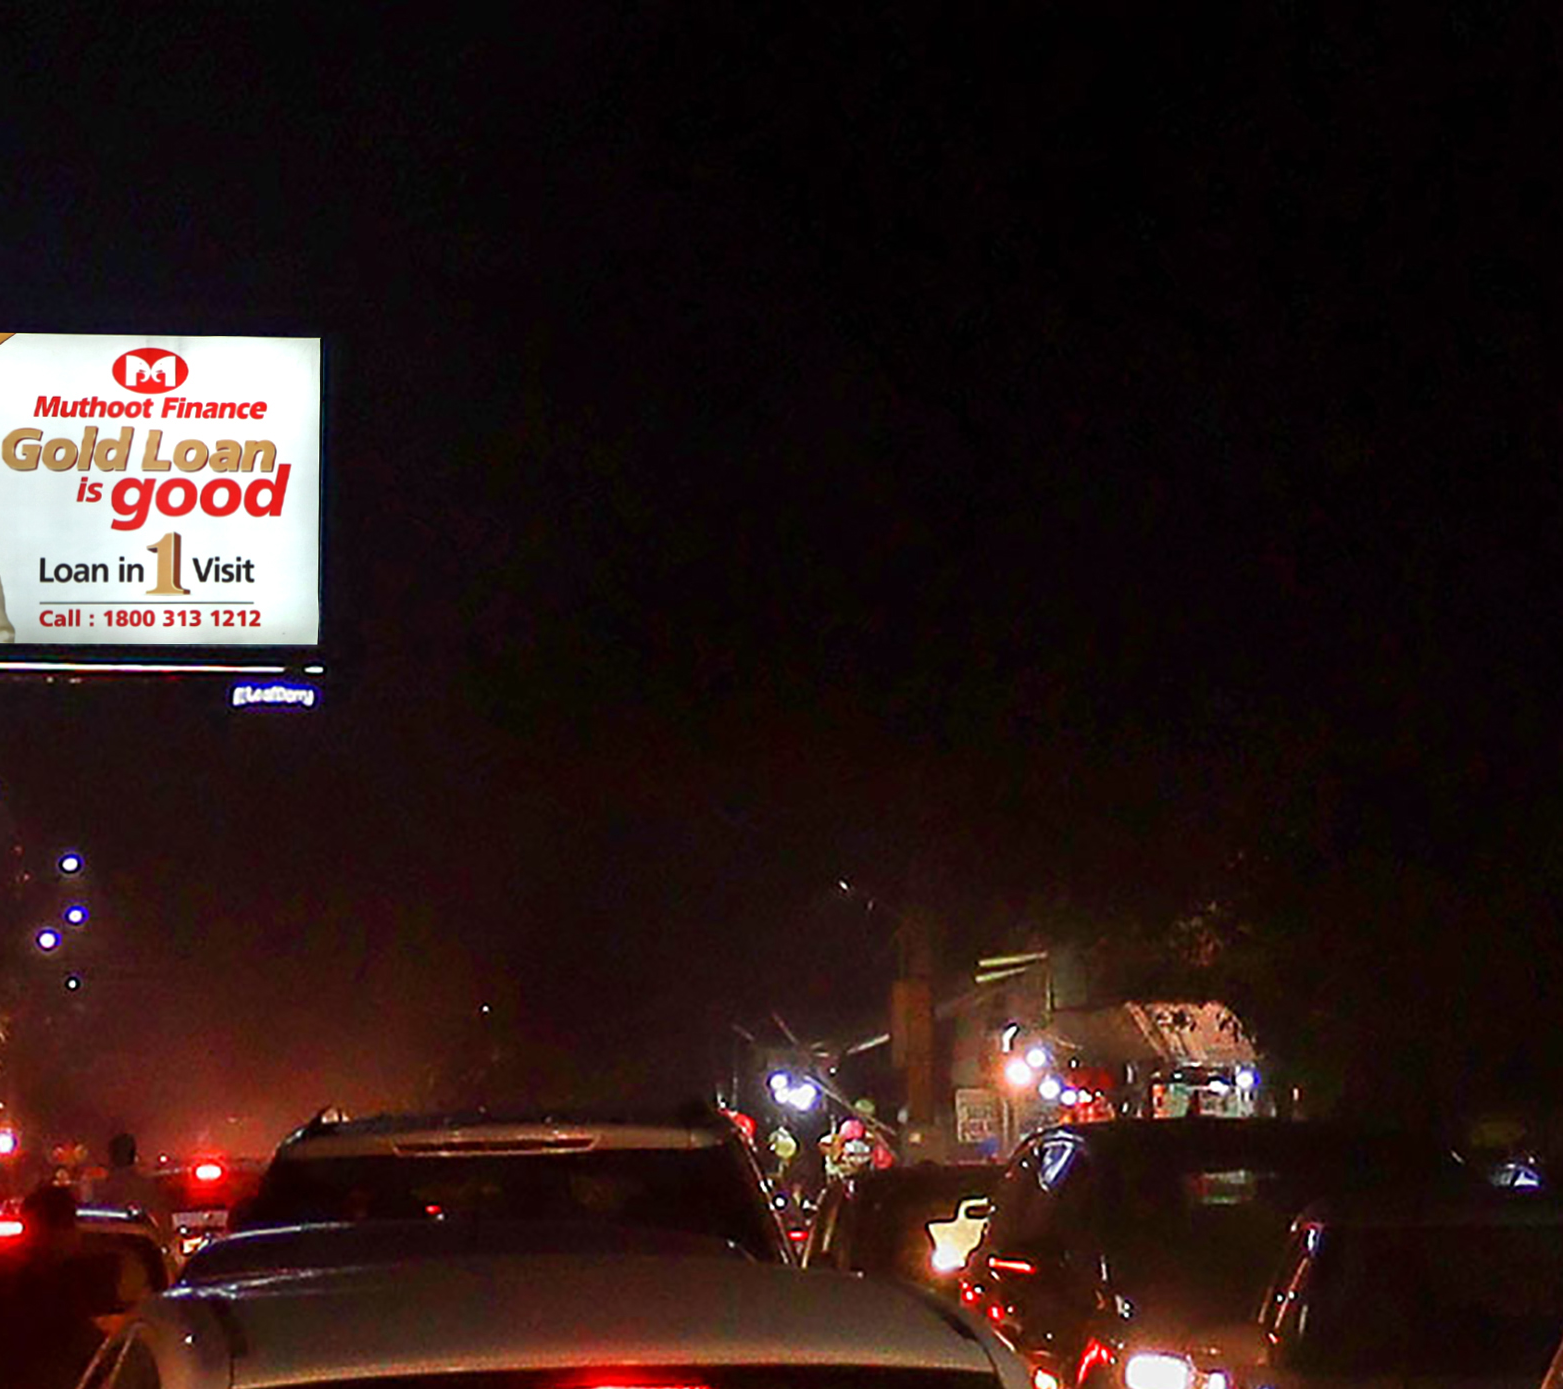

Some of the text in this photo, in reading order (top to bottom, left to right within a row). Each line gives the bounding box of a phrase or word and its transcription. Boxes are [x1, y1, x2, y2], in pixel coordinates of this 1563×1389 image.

[33, 396, 268, 420] Muthoot Finance
[2, 426, 277, 473] Gold Loan
[76, 464, 291, 531] is good
[40, 532, 255, 595] Loan in 1 Visit
[39, 609, 81, 627] Call
[103, 610, 155, 627] 1800
[163, 610, 201, 627] 313
[210, 610, 261, 627] 1212
